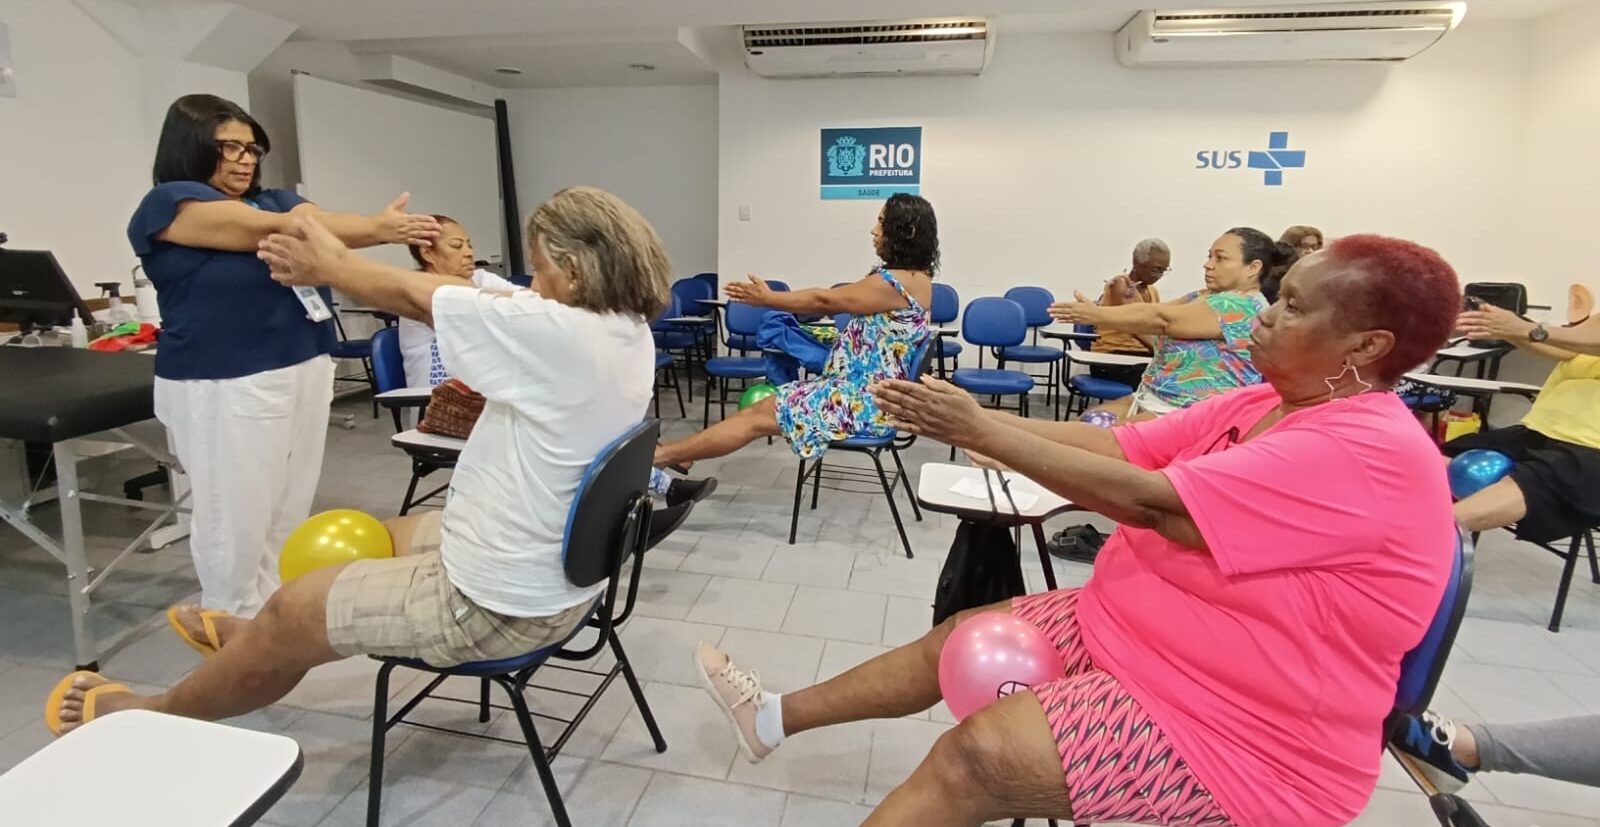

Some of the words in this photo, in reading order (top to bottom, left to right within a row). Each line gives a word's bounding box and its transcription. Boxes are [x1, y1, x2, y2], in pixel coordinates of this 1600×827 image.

[869, 144, 914, 168] RIO
[1196, 150, 1242, 169] SUS
[869, 169, 913, 177] PREFEITURA
